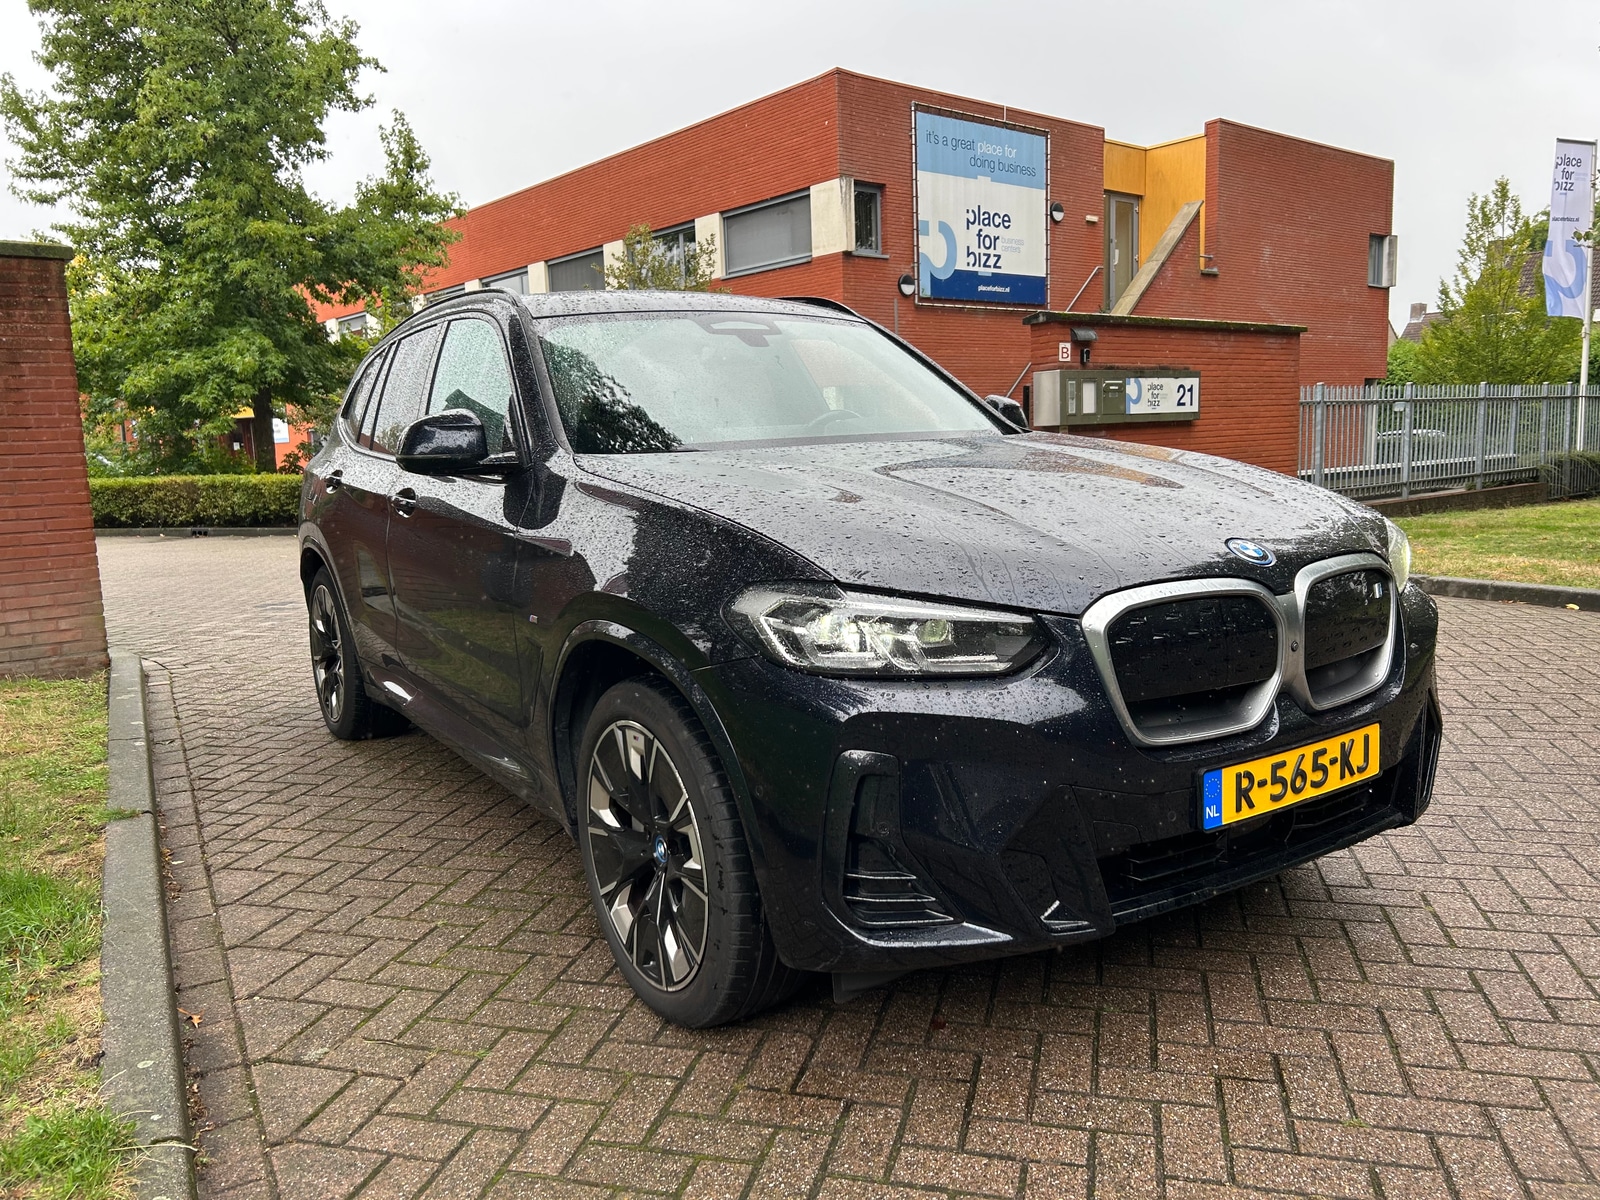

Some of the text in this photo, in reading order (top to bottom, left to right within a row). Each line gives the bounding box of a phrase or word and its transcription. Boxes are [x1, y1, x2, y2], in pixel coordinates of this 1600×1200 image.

[926, 129, 1017, 158] it's a great place for
[969, 154, 1037, 177] doing business
[1555, 153, 1582, 169] place
[1561, 167, 1575, 181] for
[1554, 178, 1574, 191] bizz
[966, 204, 1012, 230] place
[976, 228, 1000, 251] for
[966, 245, 1002, 270] bizz
[977, 284, 1010, 293] placeforbizz.nl
[1061, 346, 1070, 359] B
[1147, 382, 1164, 392] place
[1176, 383, 1194, 407] 21
[1147, 398, 1161, 407] bizz
[1150, 391, 1161, 400] for
[1235, 733, 1370, 813] R-565-KJ
[1205, 804, 1220, 820] NL
